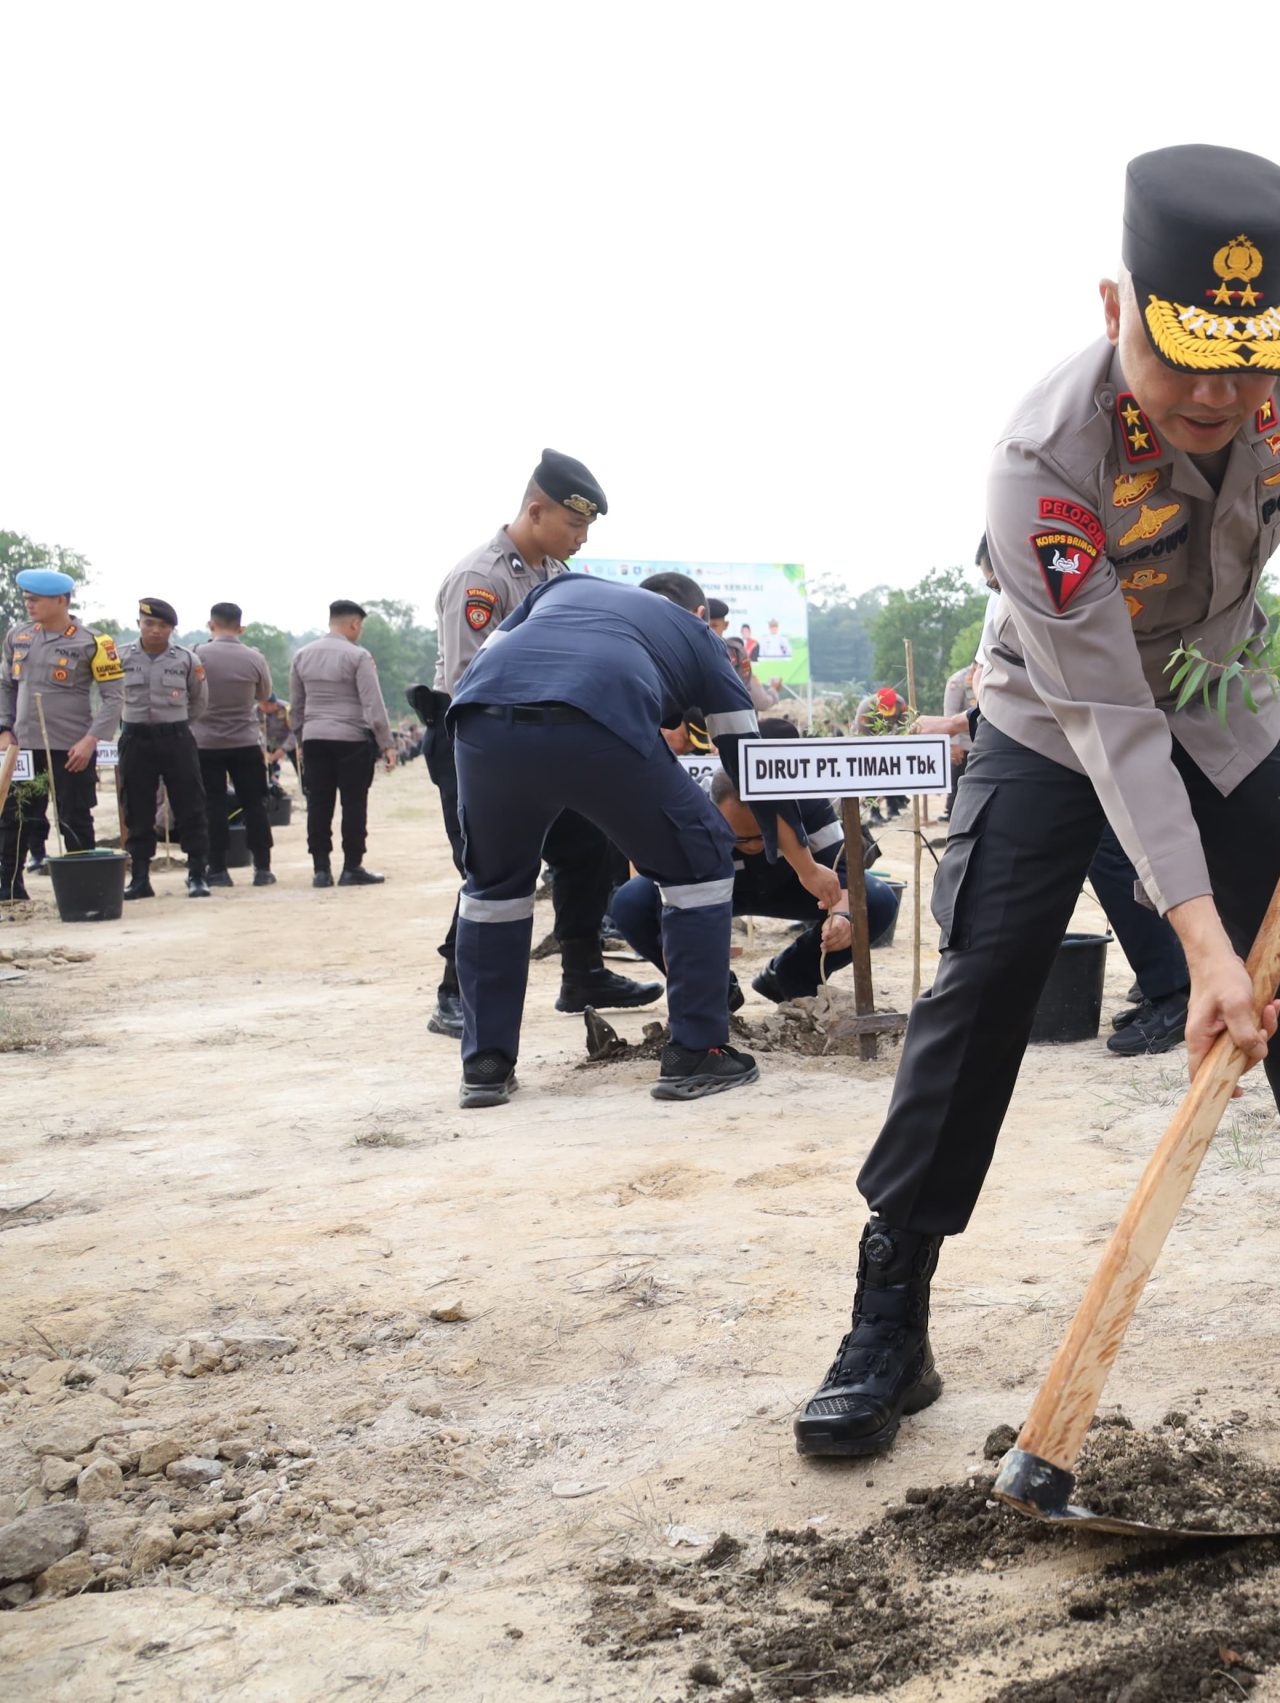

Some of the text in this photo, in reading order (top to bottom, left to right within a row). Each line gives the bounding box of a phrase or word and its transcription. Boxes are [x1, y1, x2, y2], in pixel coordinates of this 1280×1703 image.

[1035, 535, 1098, 557] KORPS BRIMOB
[755, 754, 936, 780] DIRUT PT. TIMAH Tbk
